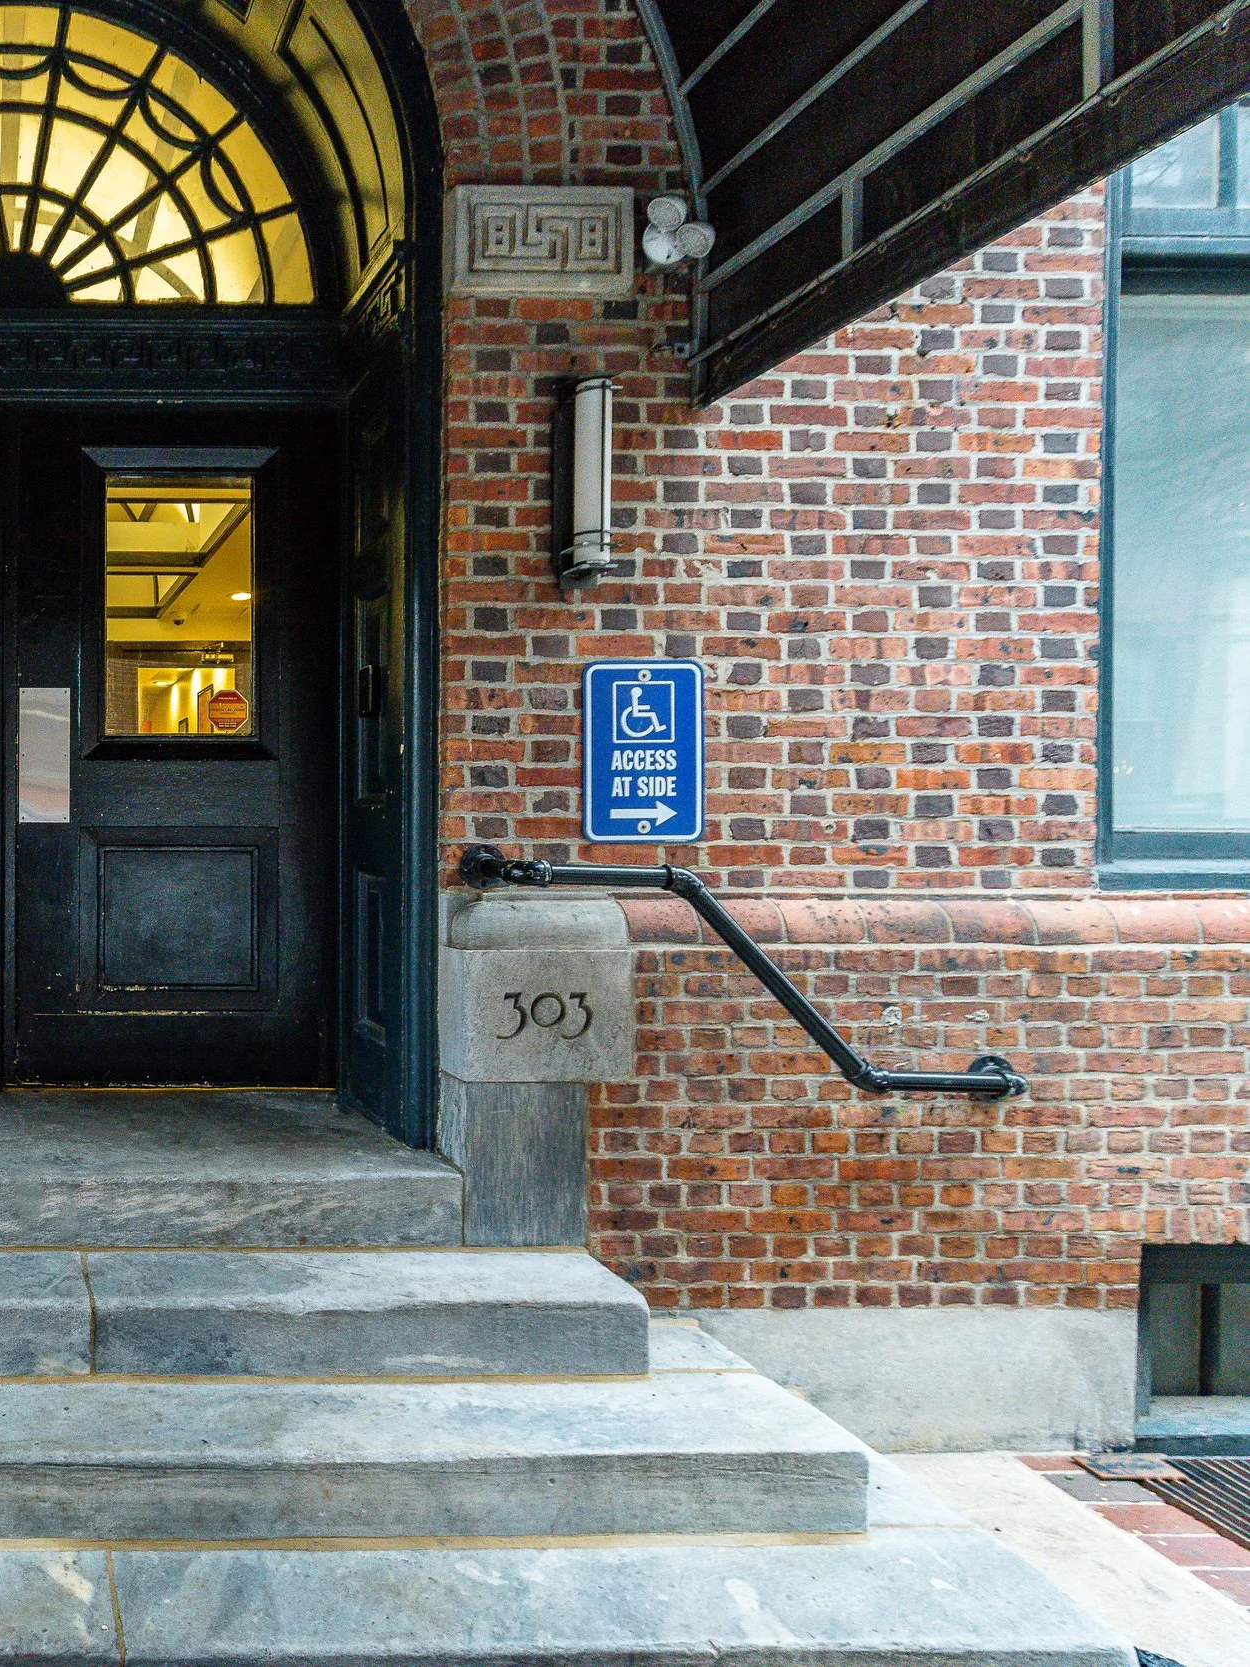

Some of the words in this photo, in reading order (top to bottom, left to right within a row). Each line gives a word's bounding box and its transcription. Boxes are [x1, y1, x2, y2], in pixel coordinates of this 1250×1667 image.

[611, 750, 677, 771] ACCESS
[611, 776, 633, 797] AT
[637, 776, 677, 797] SIDE
[496, 991, 594, 1040] 303
